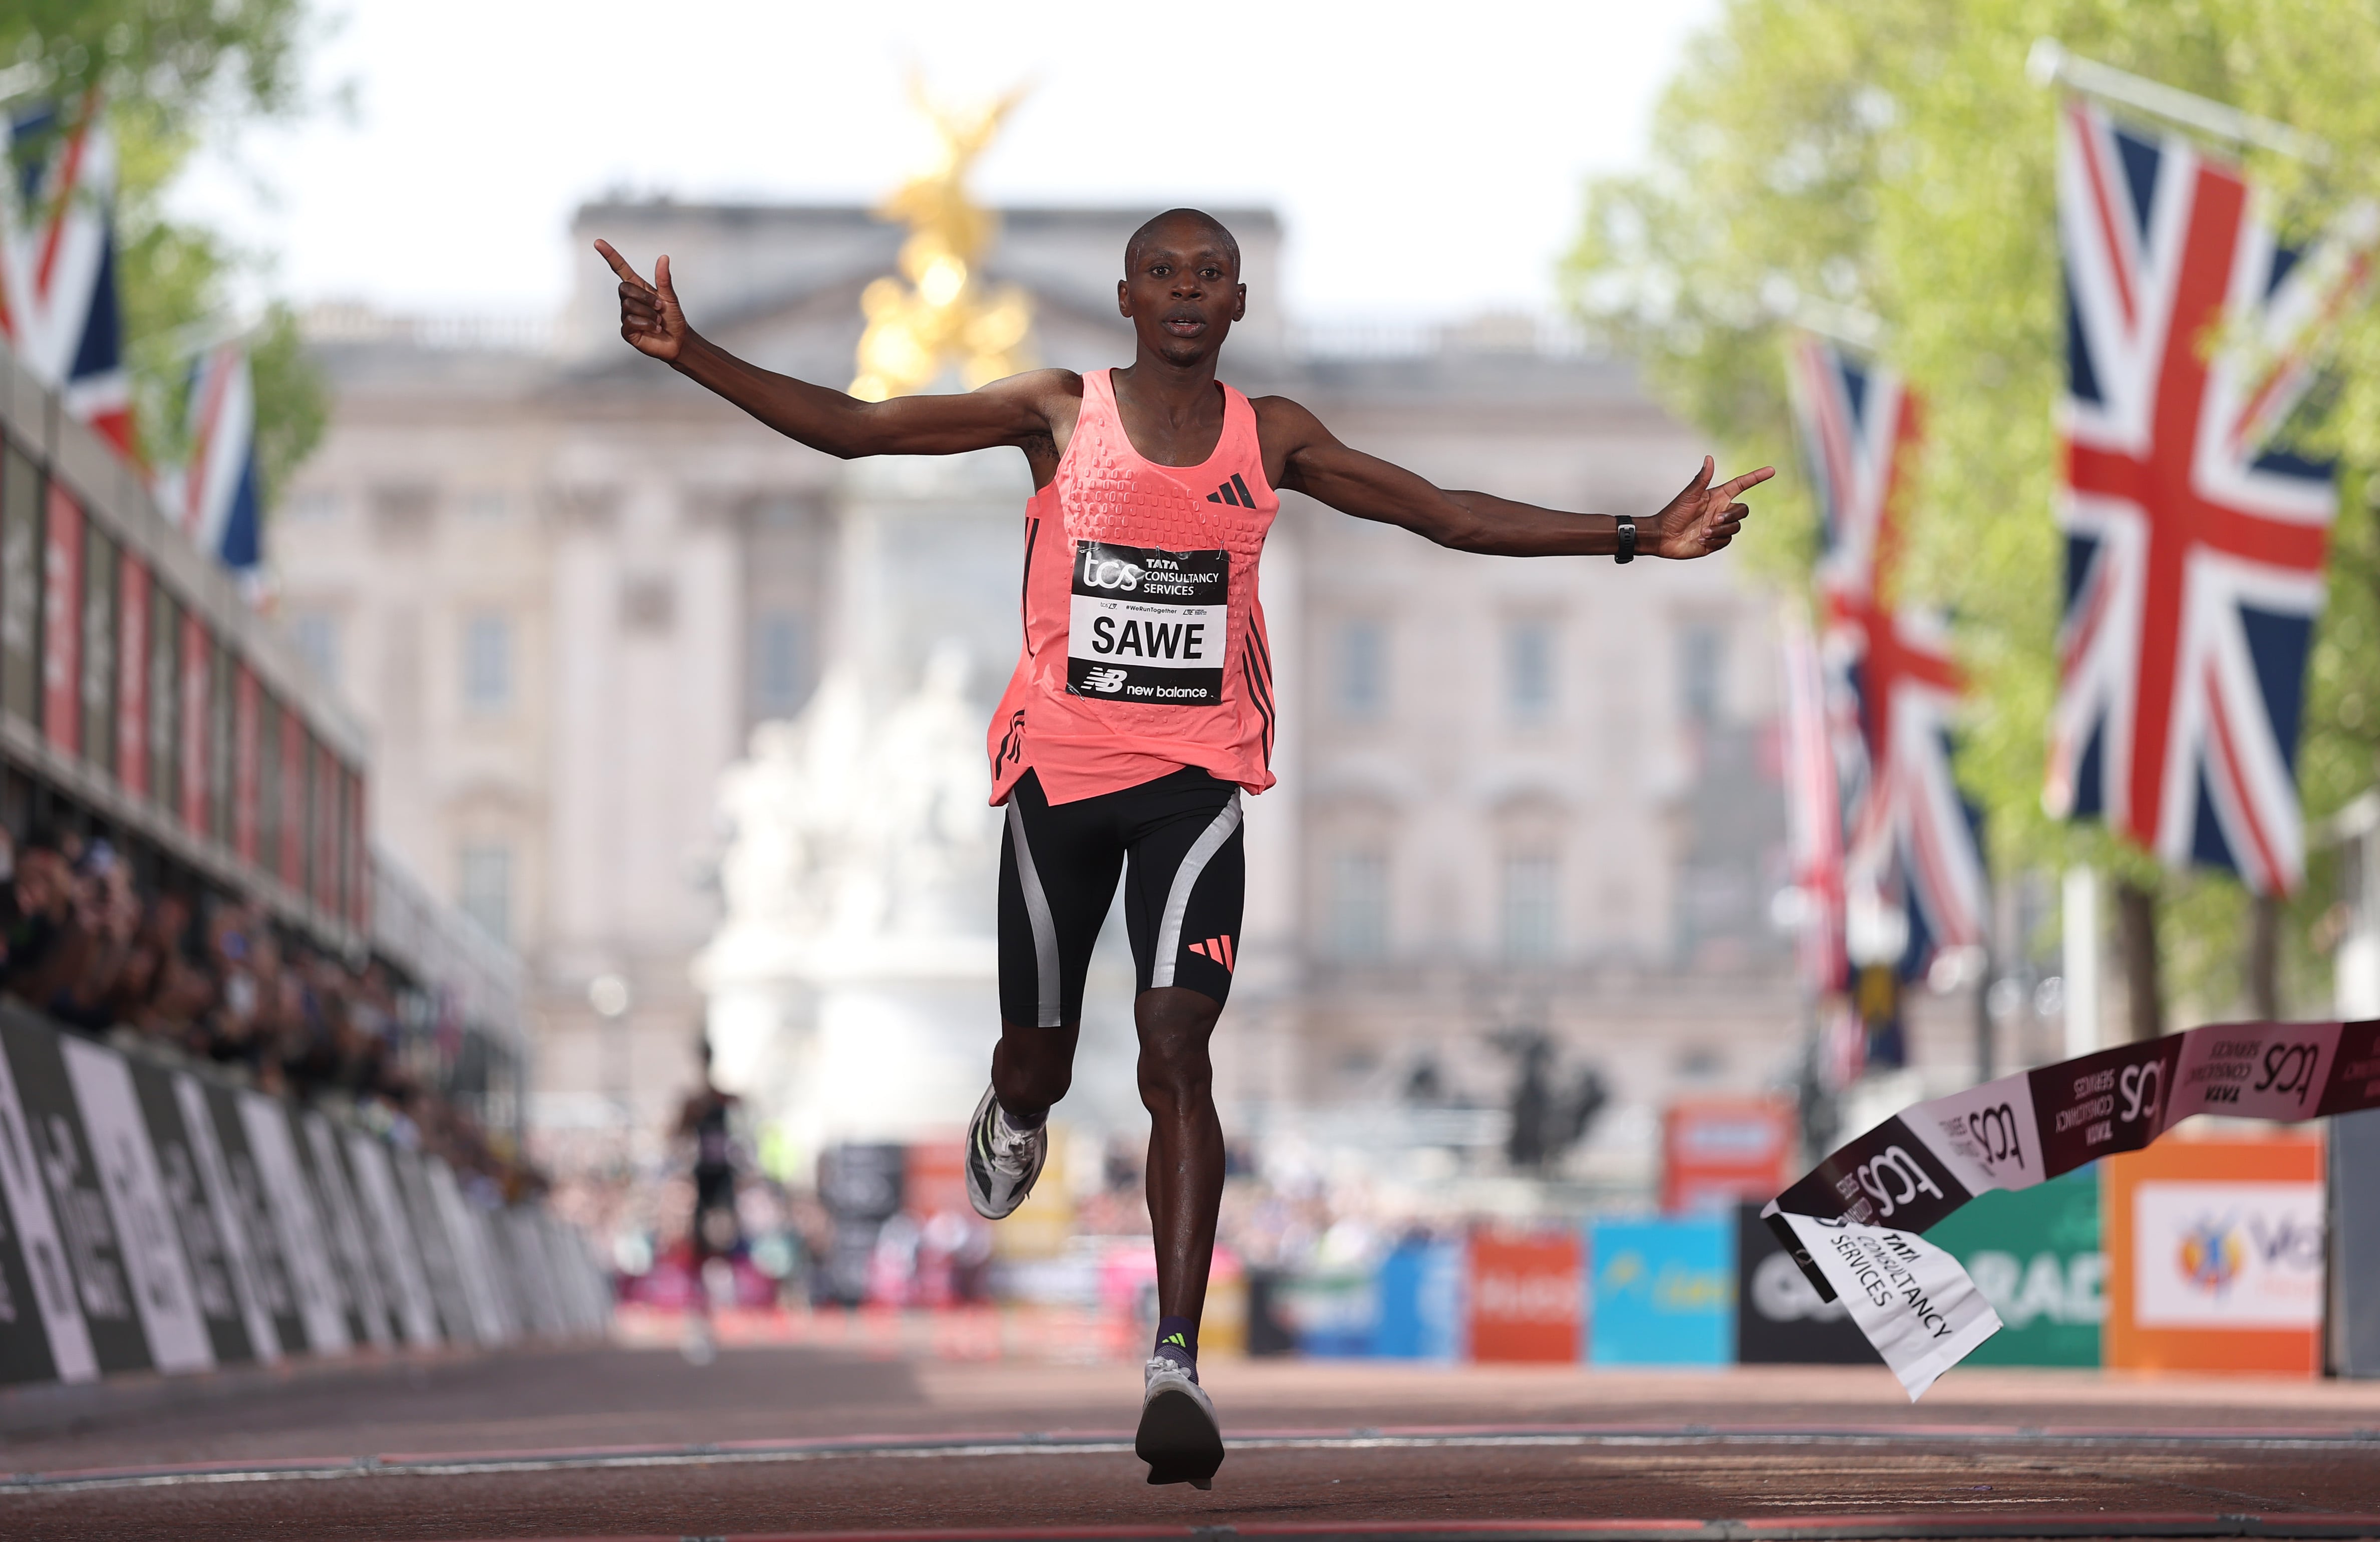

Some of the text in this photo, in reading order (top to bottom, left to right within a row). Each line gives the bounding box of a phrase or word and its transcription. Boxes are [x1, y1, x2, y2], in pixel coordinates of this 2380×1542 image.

[1083, 551, 1138, 591] tcs
[1145, 572, 1219, 583] CONSULTANCY
[1146, 559, 1179, 570] TATA
[1143, 583, 1194, 596] SERVICES
[1126, 605, 1177, 614] #WeRunTogether
[1091, 616, 1205, 659] SAWE
[1127, 685, 1208, 698] new balance
[2255, 1042, 2318, 1106] tcs
[2205, 1085, 2241, 1103] TATA
[1969, 1102, 2025, 1170] tcs
[1857, 1145, 1944, 1217] tcs
[1882, 1232, 1921, 1263] TATA
[1830, 1233, 1893, 1307] SERVICES
[1857, 1235, 1952, 1339] CONSULTANCY
